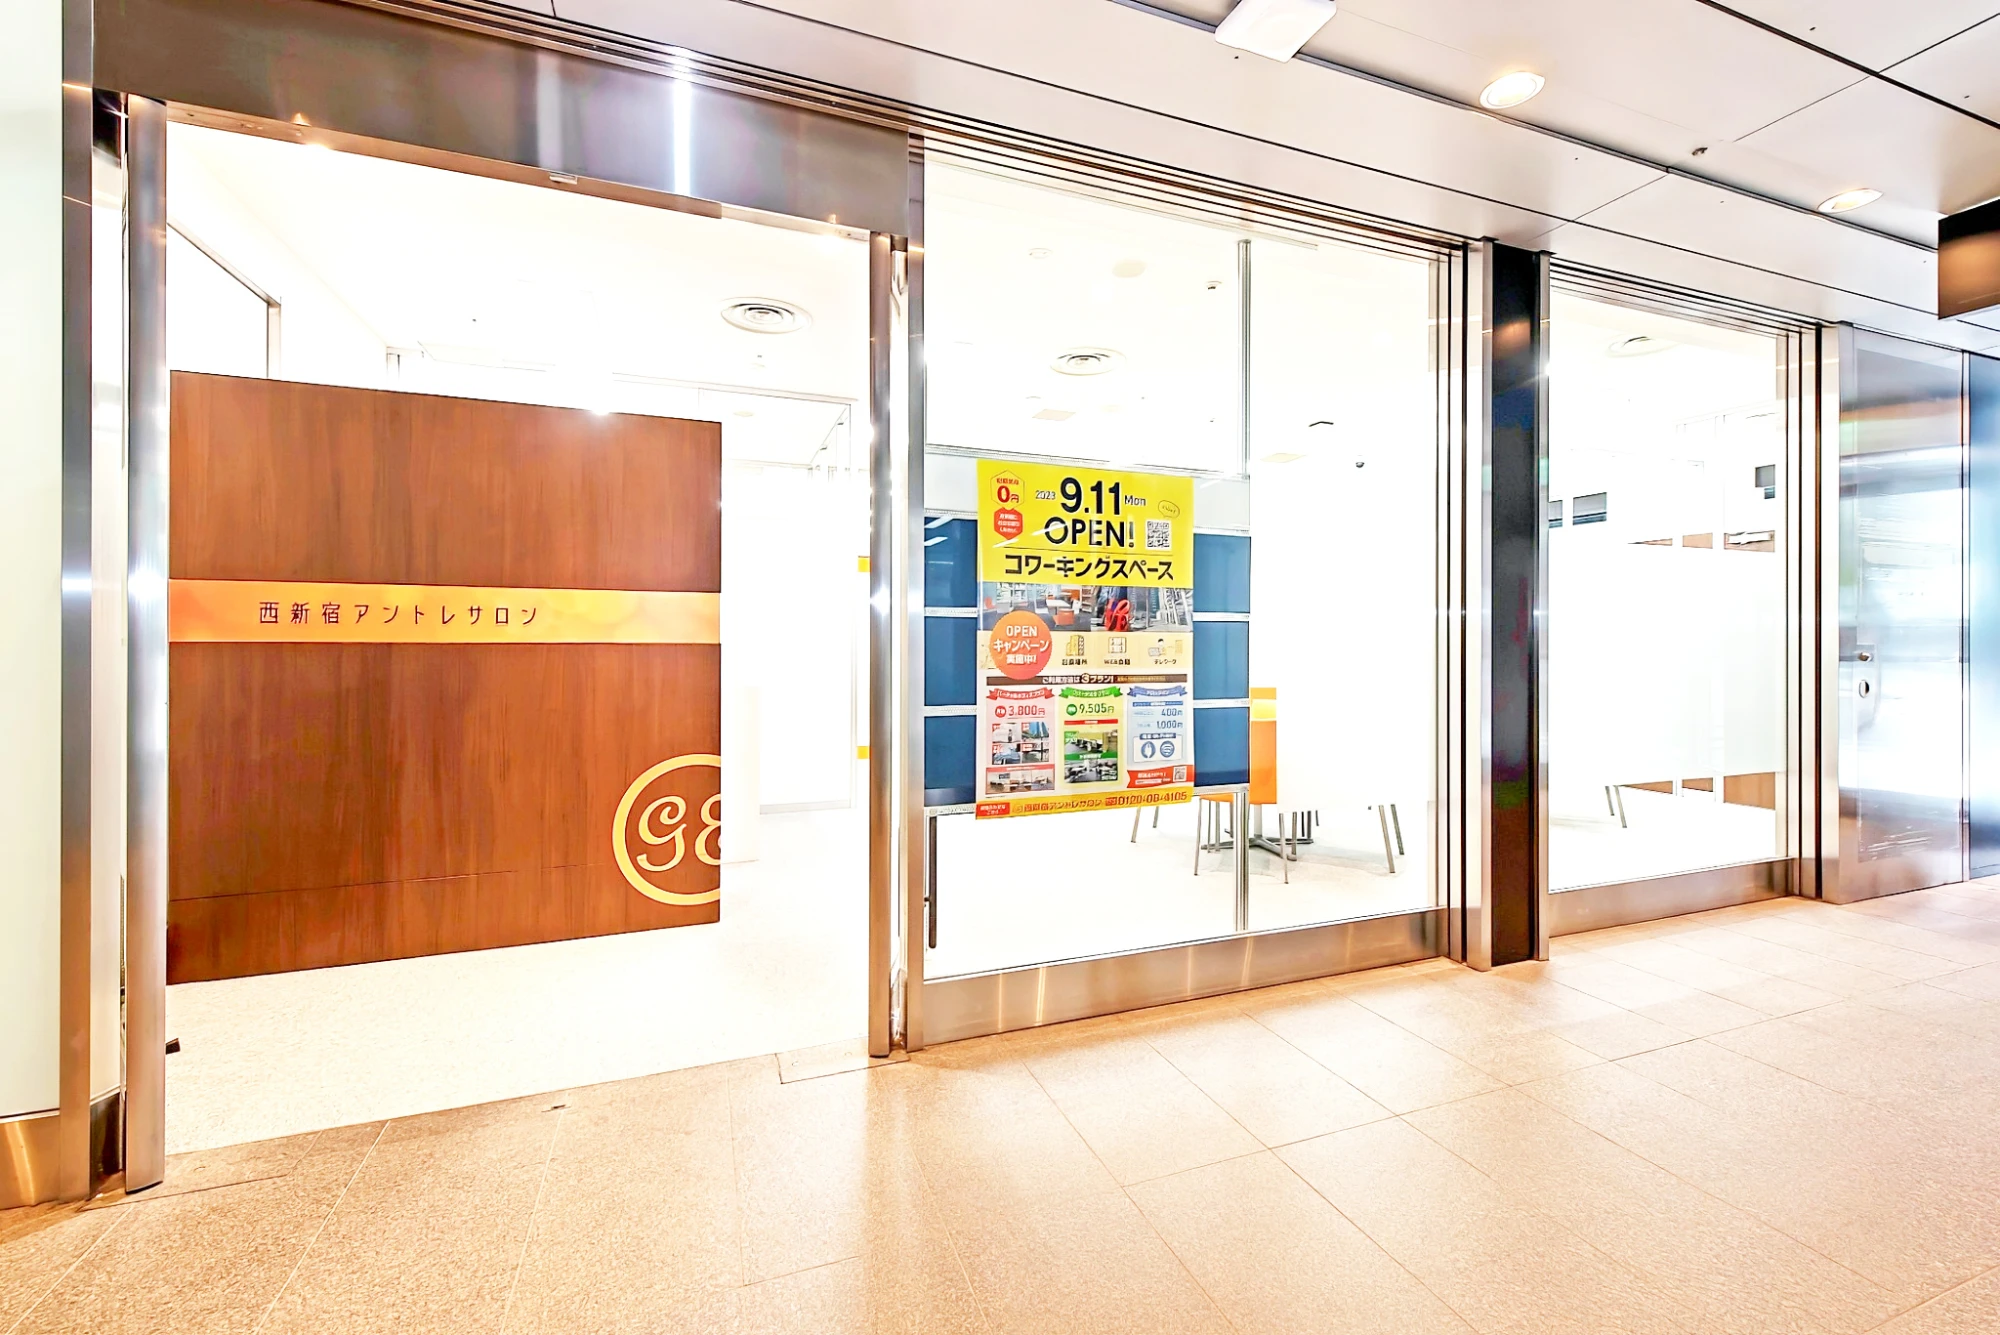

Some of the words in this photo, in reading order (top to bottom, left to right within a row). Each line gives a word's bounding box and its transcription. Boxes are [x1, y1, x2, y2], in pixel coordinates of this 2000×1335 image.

[1060, 477, 1120, 515] 9.11
[1124, 495, 1146, 506] Mon
[1044, 516, 1134, 548] OPEN!
[1005, 554, 1174, 581] コワーキングスペース
[259, 602, 537, 625] 西新宿アントレサロン
[1006, 625, 1038, 637] OPEN
[993, 638, 1050, 652] キャンペーン
